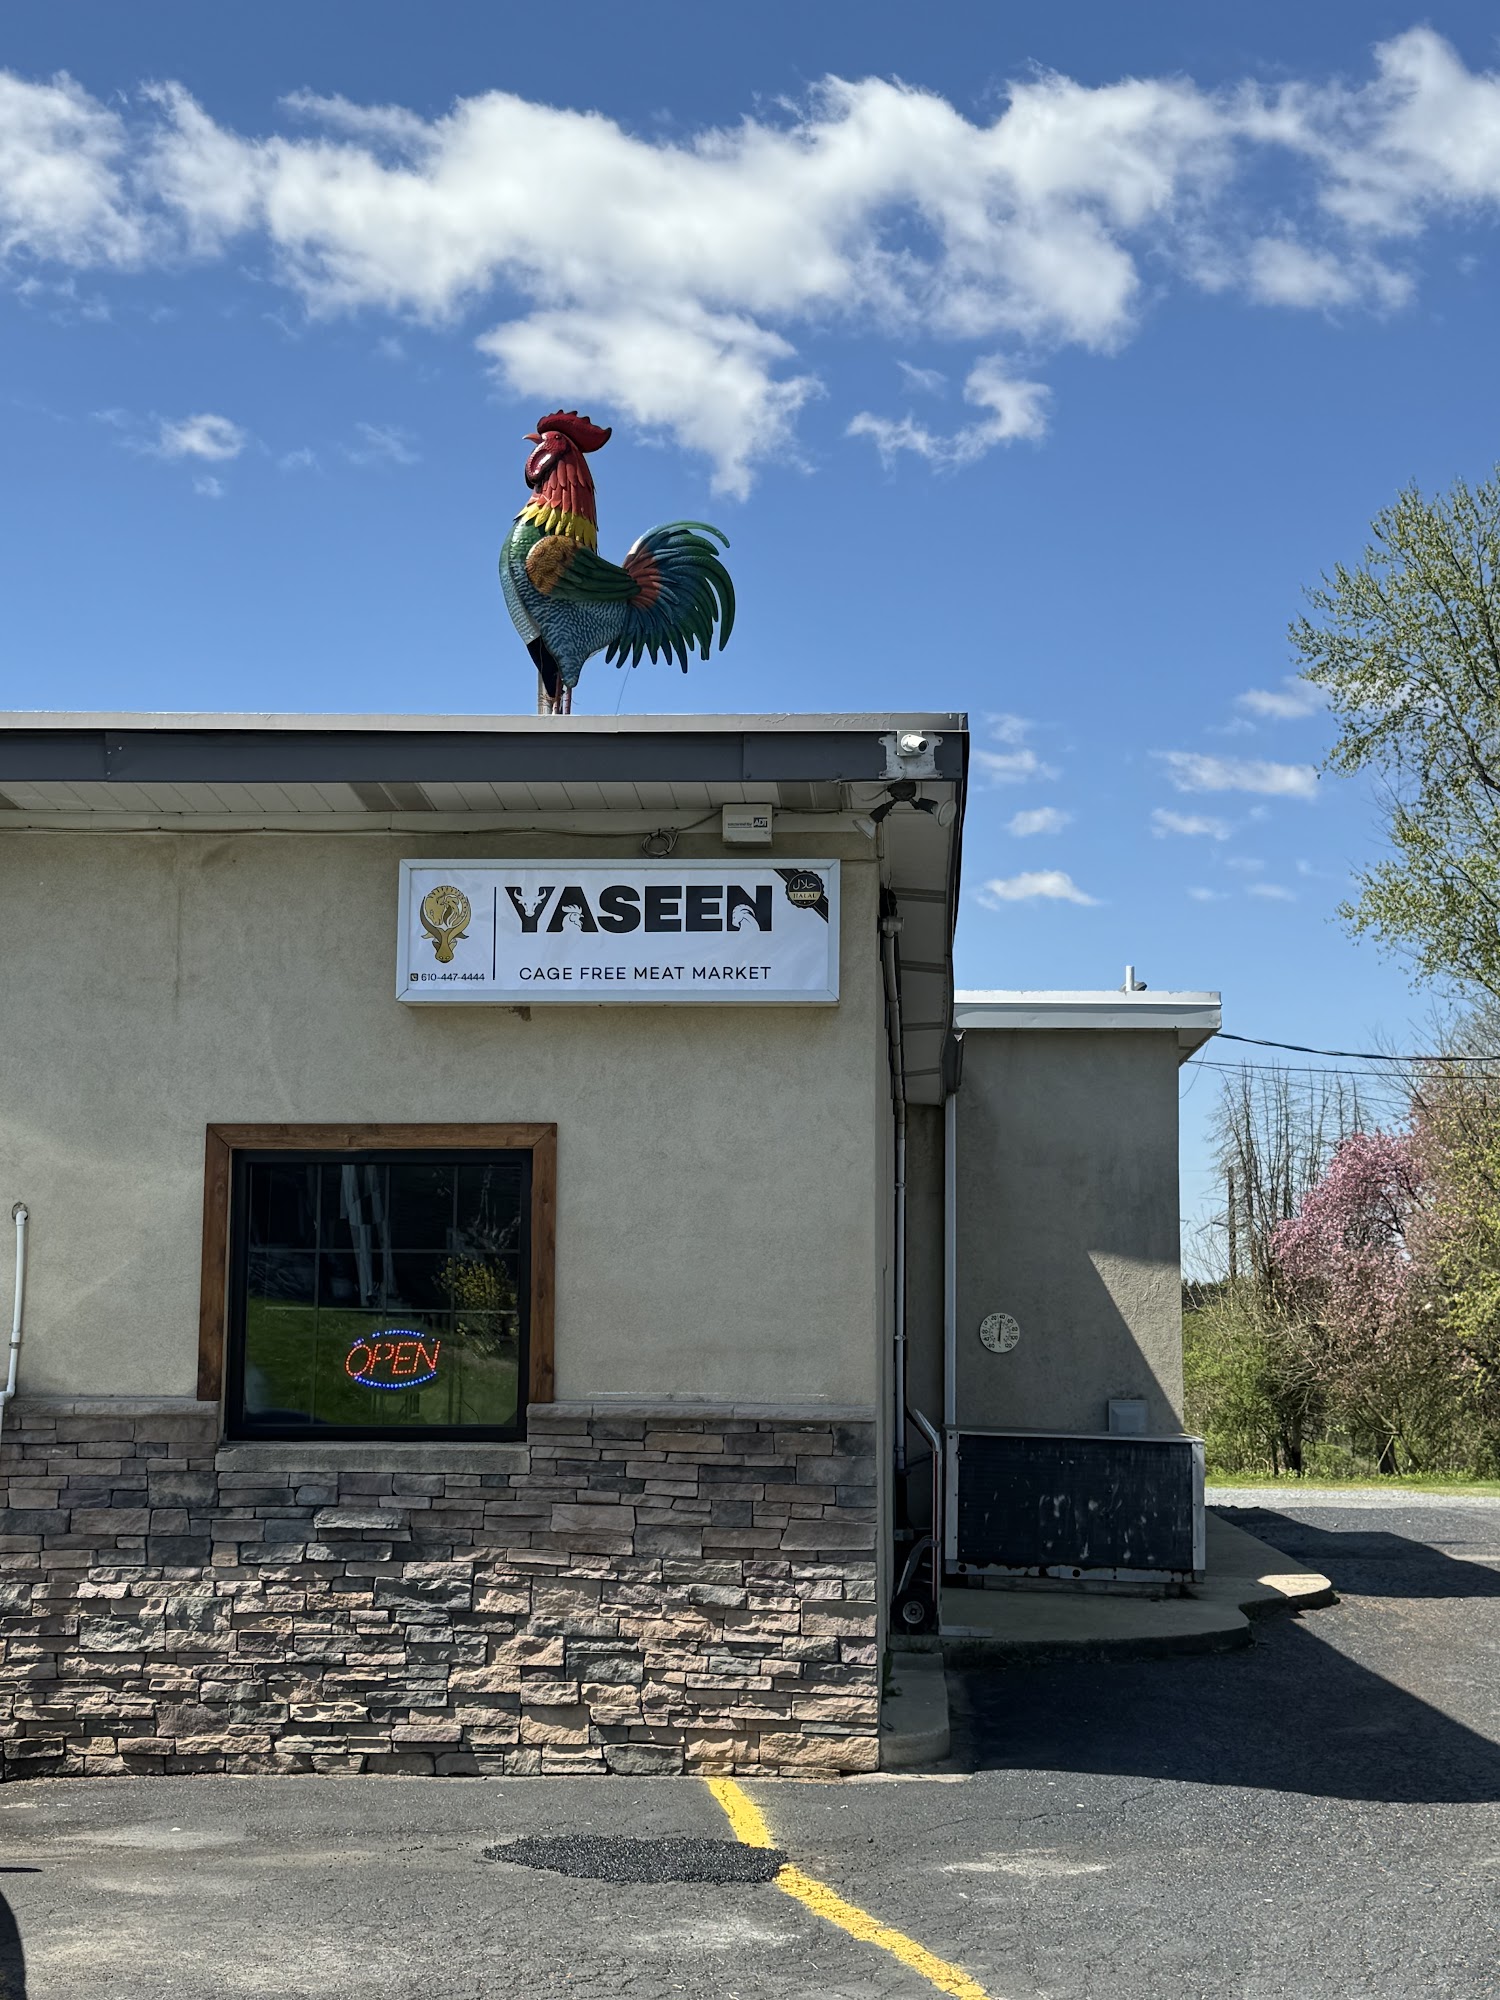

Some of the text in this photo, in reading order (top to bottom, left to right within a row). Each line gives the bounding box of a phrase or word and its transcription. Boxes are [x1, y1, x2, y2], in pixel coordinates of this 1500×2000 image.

[754, 818, 768, 827] ADT
[792, 879, 817, 890] حلال
[504, 885, 773, 933] YASEEN
[421, 973, 485, 981] 610-447-4444
[519, 966, 772, 980] CAGE FREE MEAT MARKET
[344, 1340, 441, 1376] OPEN
